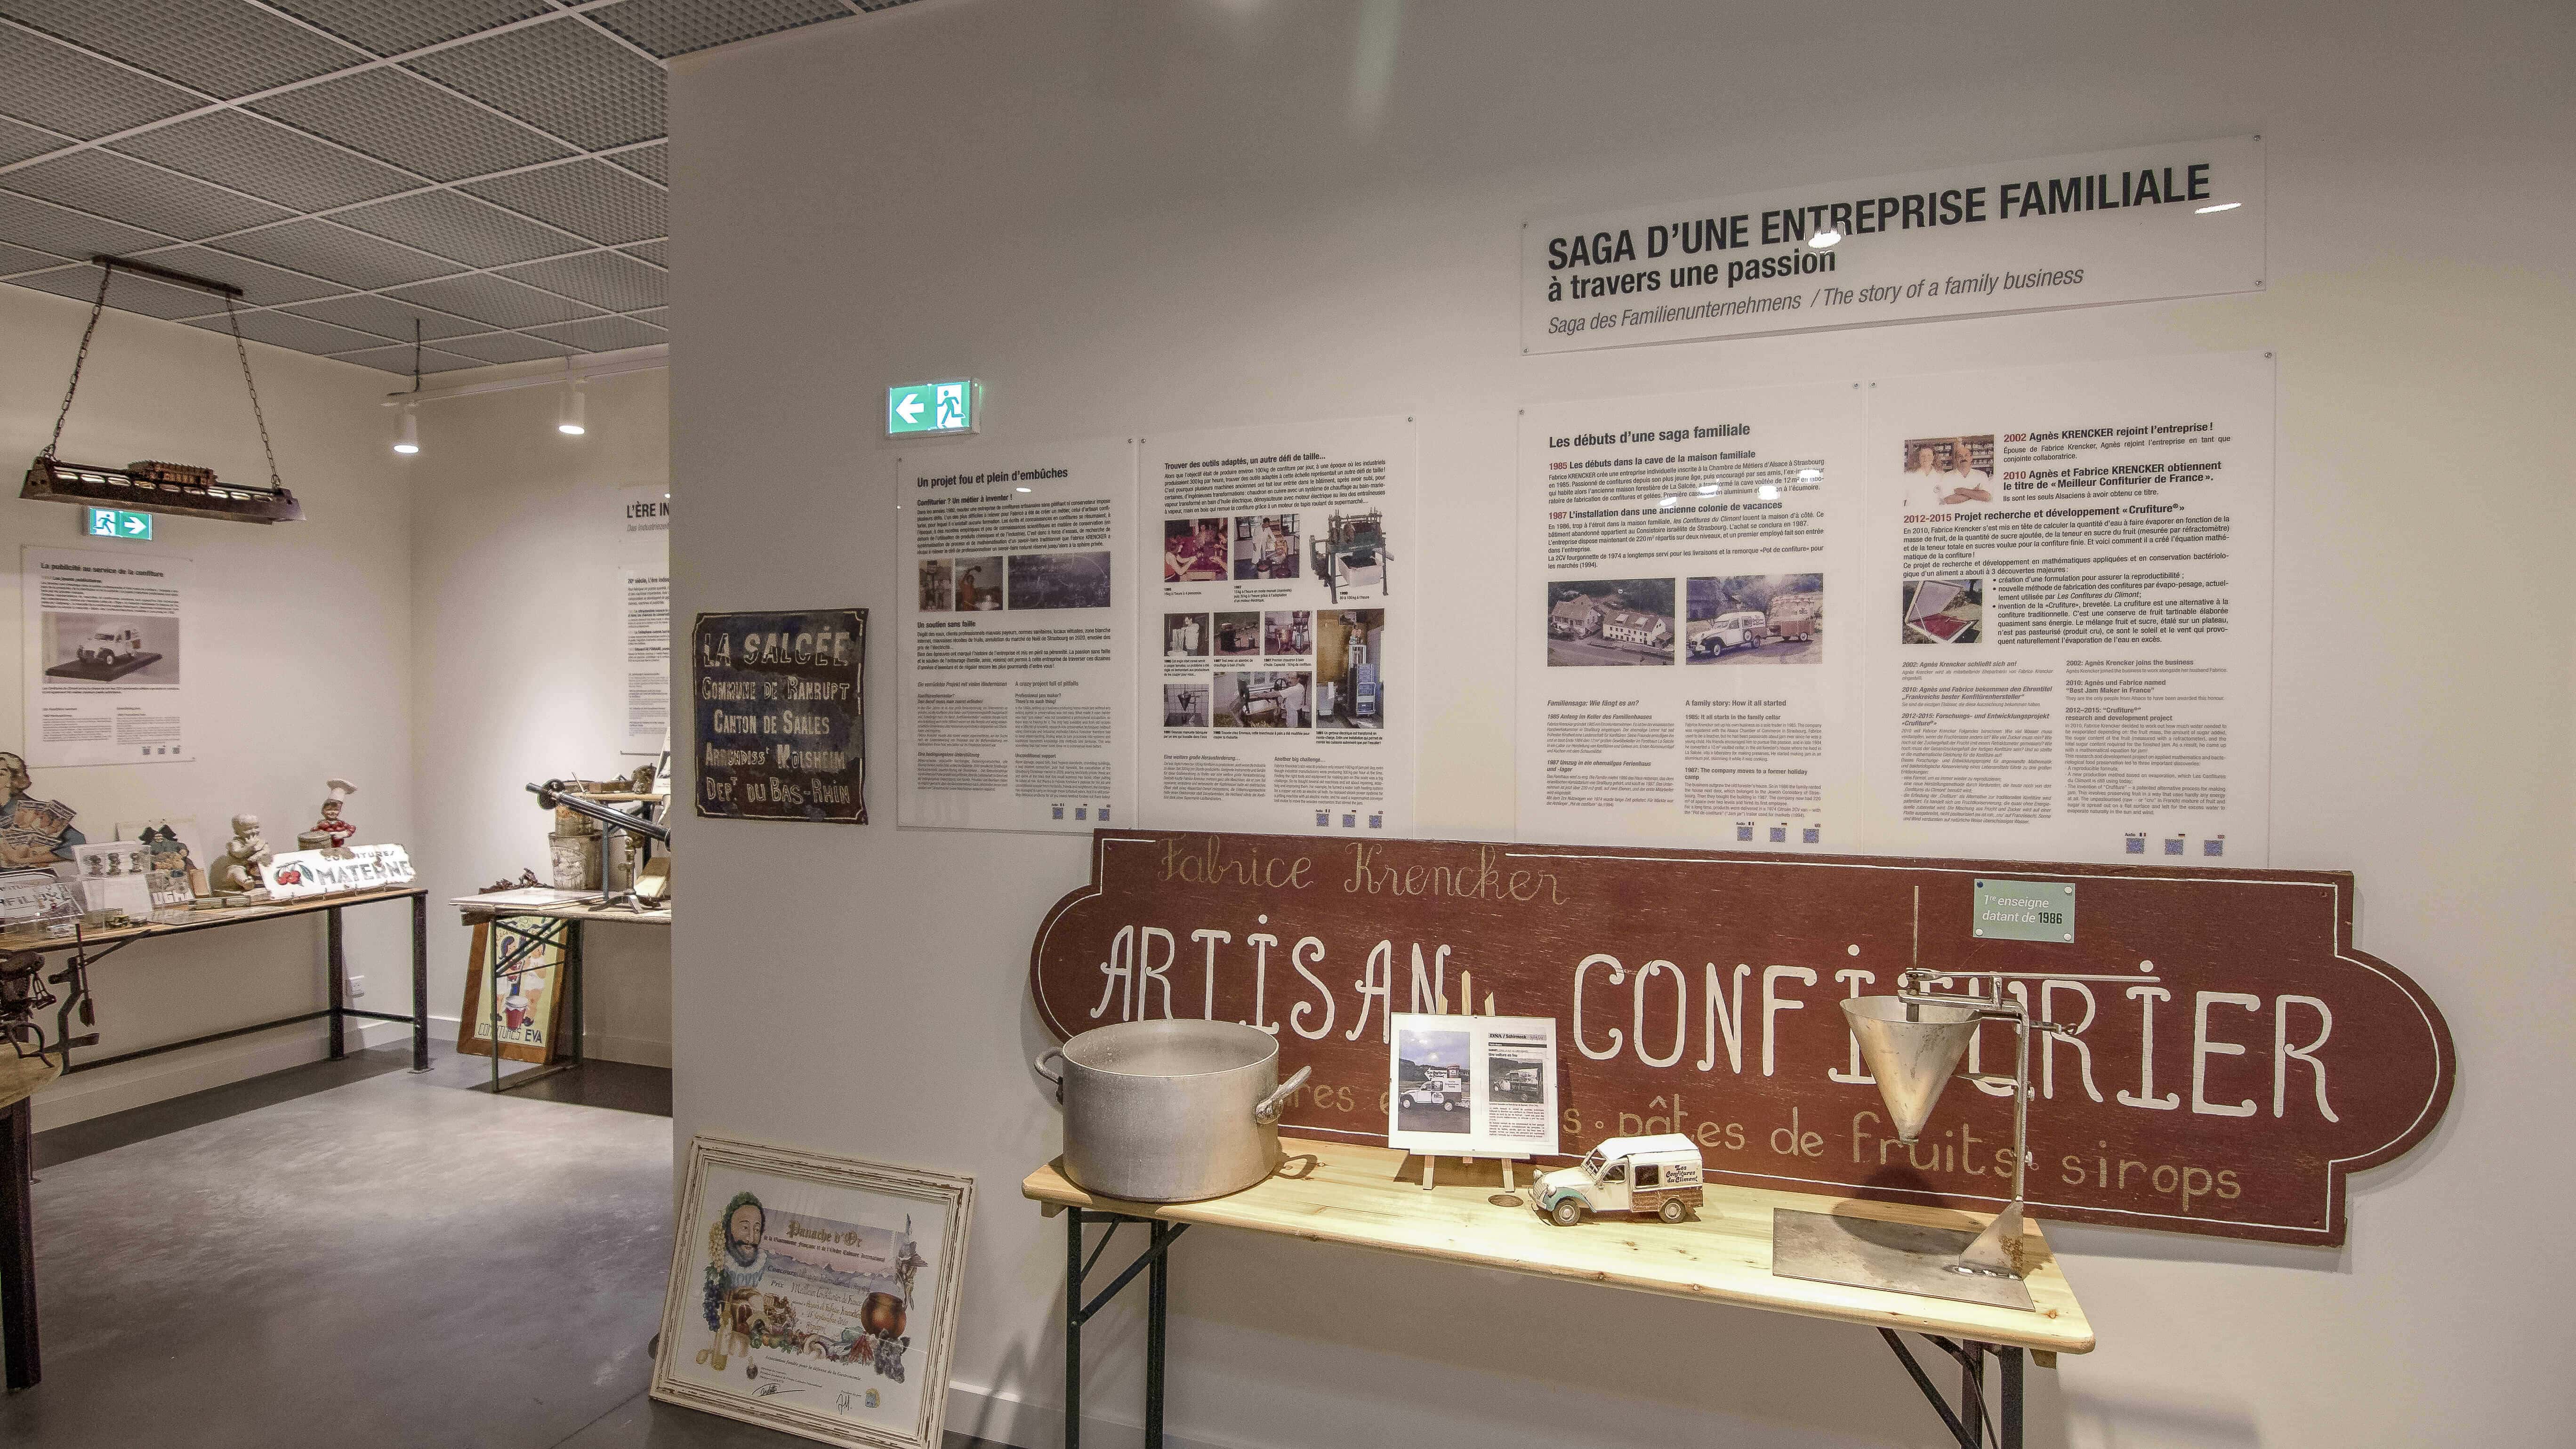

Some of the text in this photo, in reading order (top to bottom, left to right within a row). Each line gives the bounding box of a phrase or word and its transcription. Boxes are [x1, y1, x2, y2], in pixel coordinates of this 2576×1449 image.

[1548, 163, 2211, 270] SAGA D'UNE ENTREPRISE FAMILIALE
[1548, 246, 1835, 302] à travers une passion
[1548, 317, 1586, 337] Saga
[1590, 312, 1617, 330] des
[1621, 295, 1801, 326] Familienunternehmens
[1823, 287, 1853, 306] The
[1859, 285, 1903, 304] story
[1907, 279, 1925, 298] of
[1928, 282, 1939, 296] a
[1945, 274, 1999, 295] family
[2004, 269, 2084, 290] business
[1550, 424, 1750, 448] Les débuts d'une saga familiale
[2004, 434, 2026, 442] 2002
[2029, 431, 2059, 442] Agnès
[2062, 428, 2113, 439] KRENCKER
[2117, 427, 2149, 437] rejoint
[2004, 446, 2026, 454] Épouse
[1220, 458, 1248, 467] adaptés,
[1279, 455, 1291, 463] défi
[1585, 459, 1611, 469] débuts
[1614, 458, 1637, 466] dans
[1688, 453, 1717, 462] maison
[1720, 451, 1755, 459] familiale
[918, 468, 1068, 489] Un projet fou et plein d'embûches
[2004, 461, 2221, 482] 2010 Agnès et Fabrice KRENCKER obtiennent
[2004, 482, 2012, 490] le
[2014, 482, 2033, 490] titre
[2036, 479, 2048, 489] de
[2100, 475, 2152, 486] Confiturier
[2155, 475, 2166, 483] de
[627, 501, 656, 518] L'ÈRE
[1570, 509, 1618, 519] L'installation
[1659, 506, 1696, 514] ancienne
[1699, 504, 1728, 512] colonie
[1904, 514, 1951, 523] 2012-2015
[1955, 512, 1982, 522] Projet
[1984, 510, 2031, 520] recherche
[2034, 510, 2044, 518] et
[2046, 507, 2120, 518] développement
[703, 633, 731, 667] LA
[1157, 833, 1571, 906] Fabrice Krencker
[1997, 896, 2049, 910] enseigne
[1982, 910, 2062, 924] datant de 1986
[1090, 914, 1451, 1045] ARTISAN
[524, 1029, 543, 1044] EVA
[1770, 1106, 1824, 1157] de
[2061, 1139, 2243, 1213] sirops
